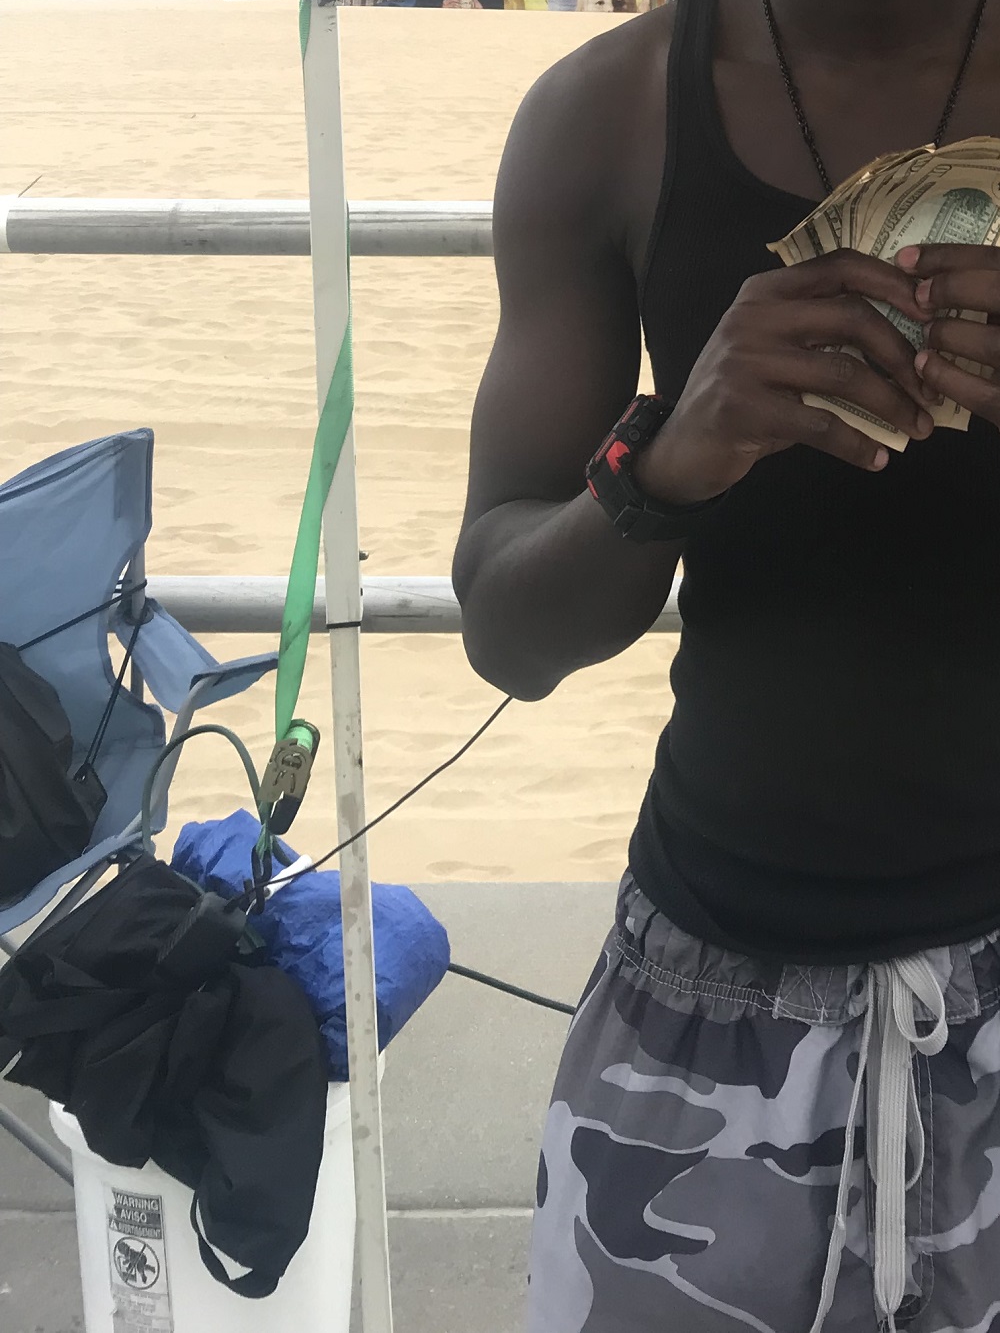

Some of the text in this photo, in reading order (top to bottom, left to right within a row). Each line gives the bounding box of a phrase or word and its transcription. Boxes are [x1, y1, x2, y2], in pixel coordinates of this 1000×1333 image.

[890, 215, 915, 251] WE TRUST
[115, 1193, 159, 1211] WARNING
[120, 1208, 147, 1223] AVISO
